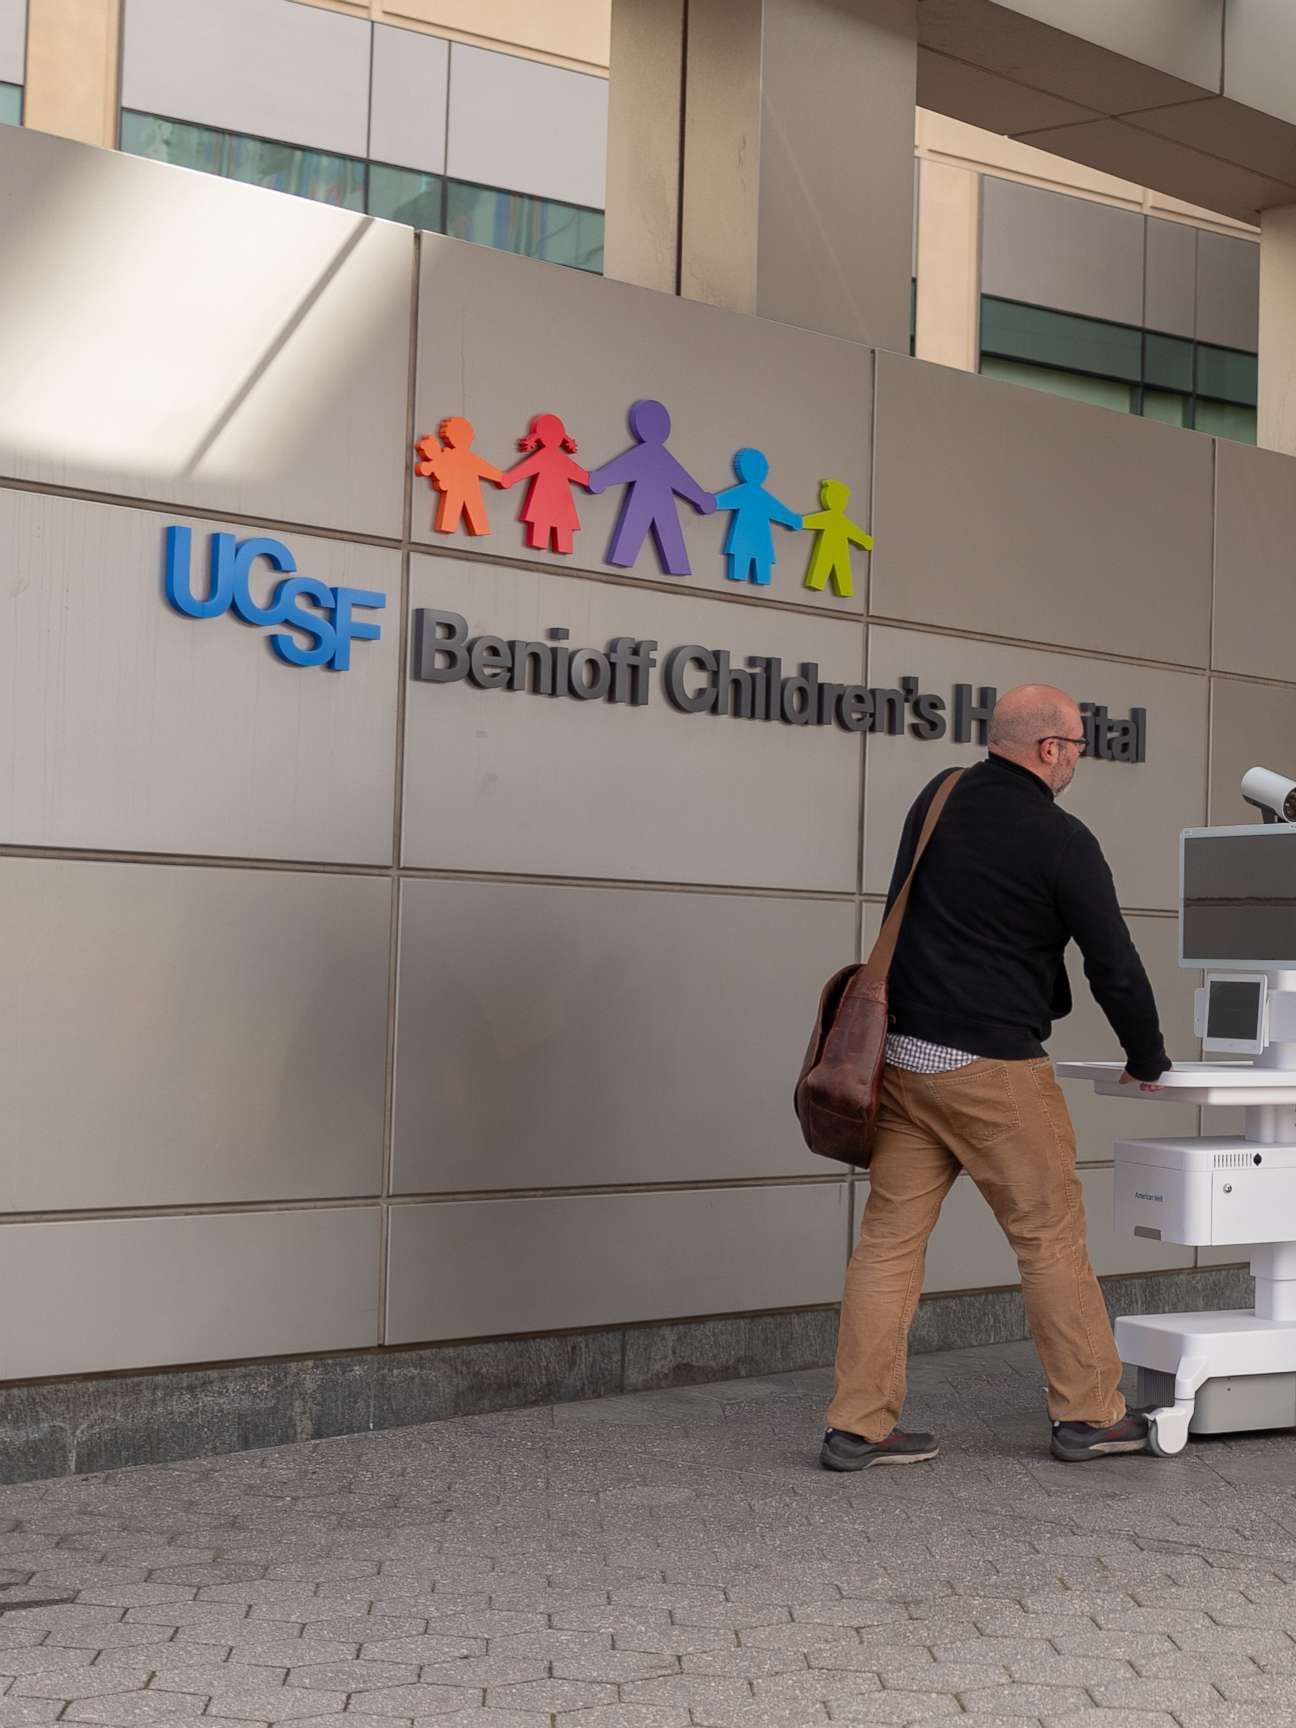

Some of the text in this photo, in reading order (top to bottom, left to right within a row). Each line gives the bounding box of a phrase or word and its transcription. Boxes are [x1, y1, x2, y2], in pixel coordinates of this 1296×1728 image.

[165, 525, 387, 672] UCSF
[414, 607, 1147, 763] Benioff Children's Hital
